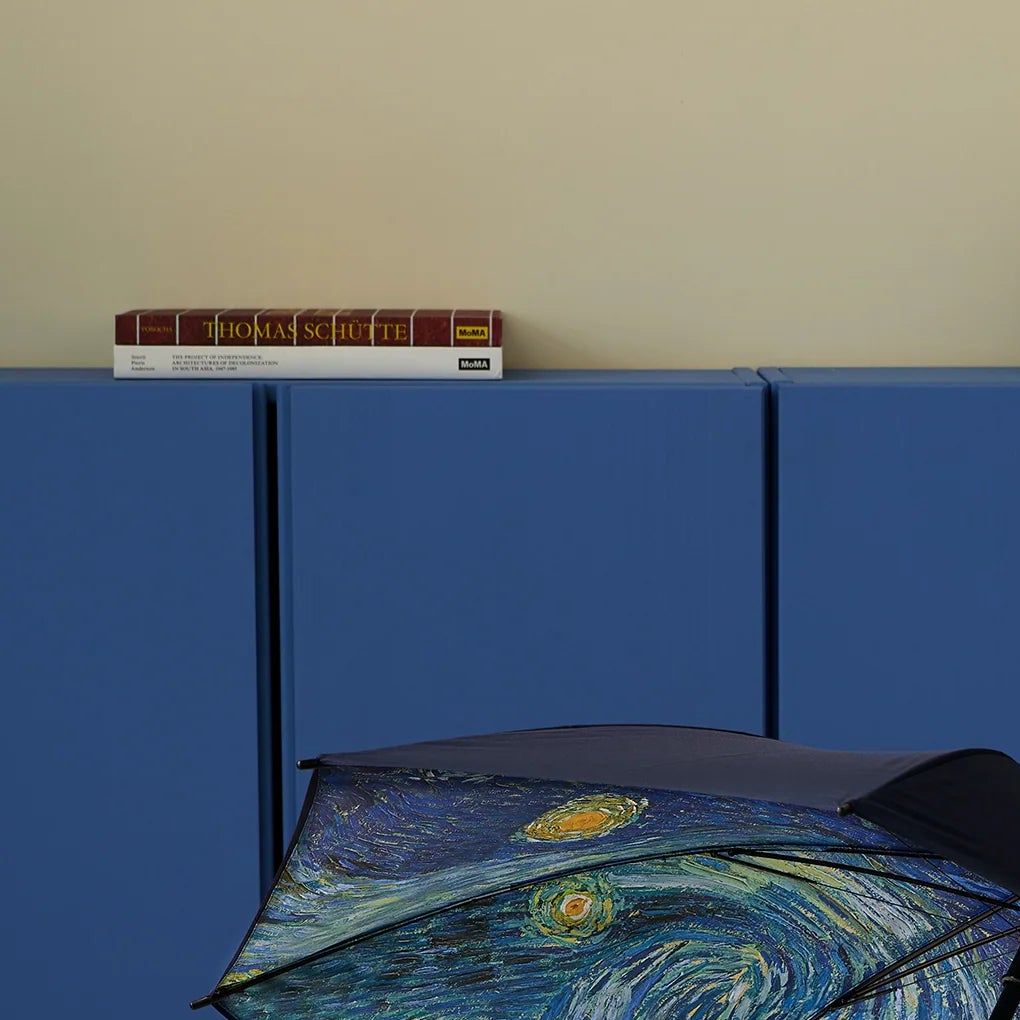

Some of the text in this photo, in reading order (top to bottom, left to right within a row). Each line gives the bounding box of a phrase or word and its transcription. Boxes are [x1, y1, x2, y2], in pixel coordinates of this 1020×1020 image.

[203, 319, 408, 341] THOMAS SCHÜTTE
[458, 328, 487, 338] MoMA
[460, 360, 489, 369] MoMA
